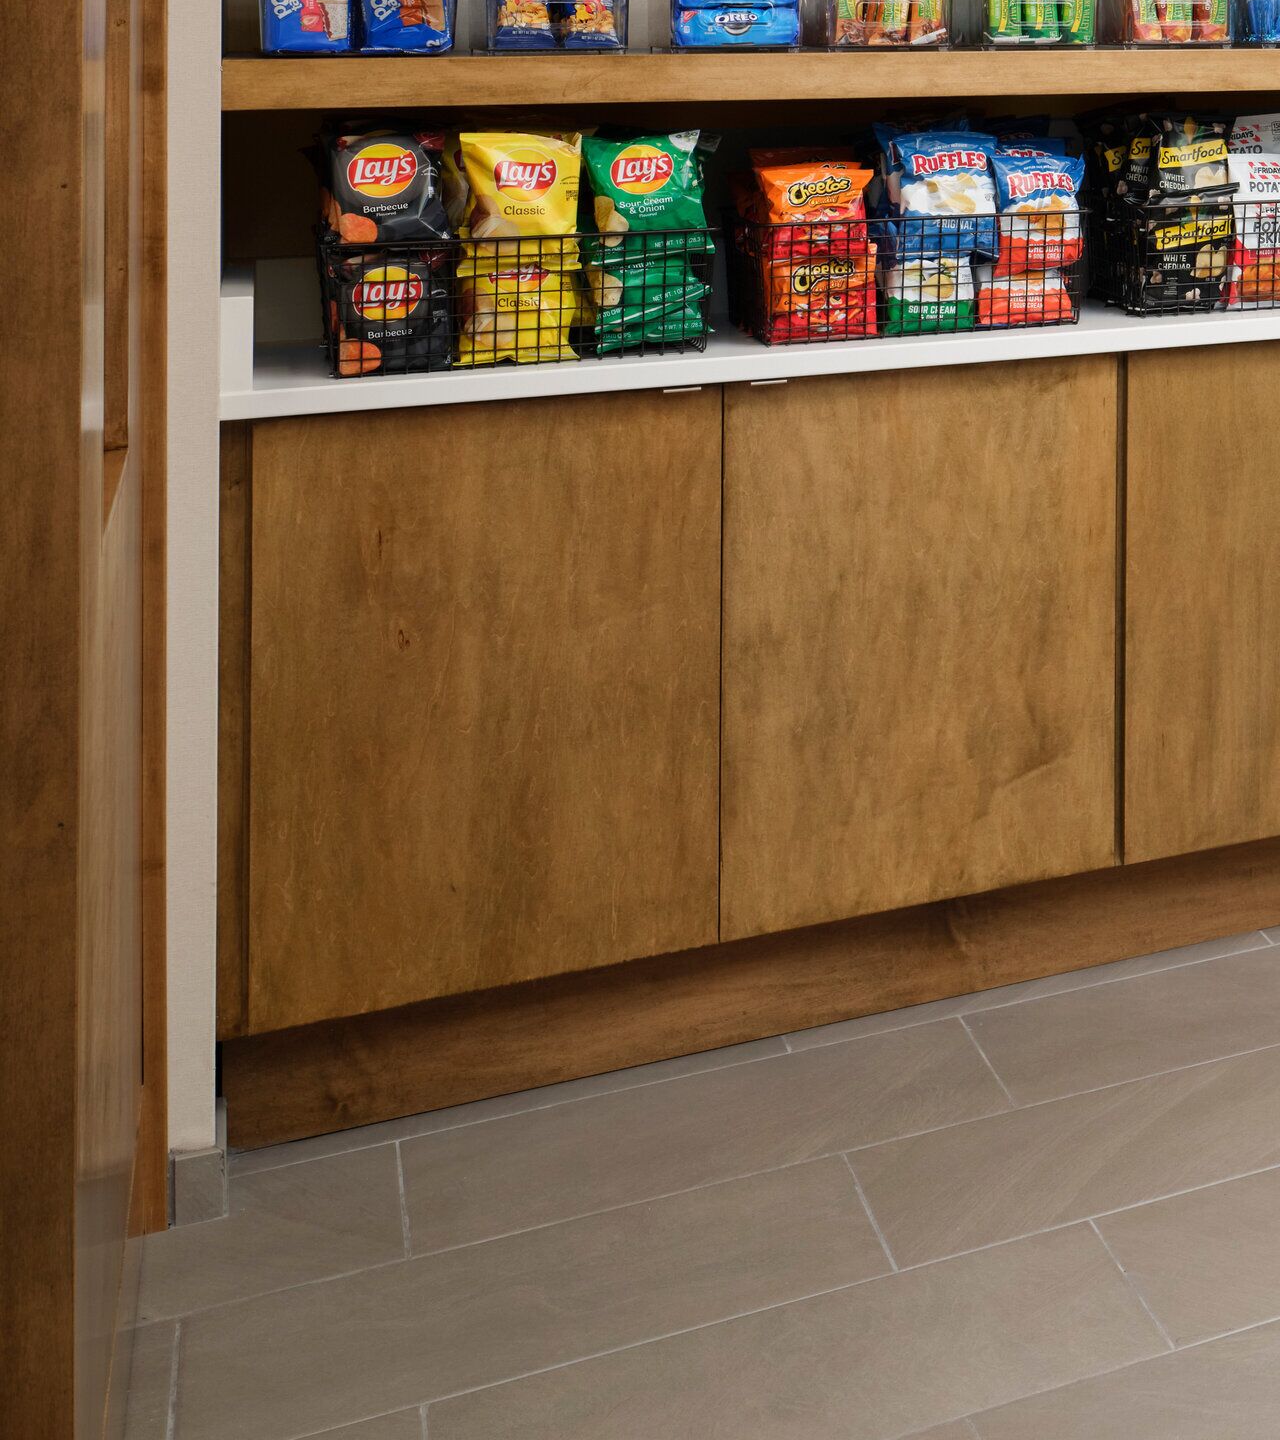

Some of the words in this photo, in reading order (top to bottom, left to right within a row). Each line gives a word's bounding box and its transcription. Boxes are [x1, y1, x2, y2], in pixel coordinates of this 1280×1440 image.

[913, 151, 988, 174] RUFFLES
[1161, 144, 1224, 165] Smartfood
[354, 154, 413, 186] Lay's
[500, 161, 554, 191] Lay's
[617, 154, 670, 184] Lay's
[1164, 172, 1185, 183] WHITE
[788, 177, 851, 206] Cheetos
[363, 201, 409, 214] Barbecue
[504, 205, 546, 216] Classic
[619, 199, 642, 210] Sour
[638, 203, 665, 214] Onion
[1161, 220, 1226, 245] Smartfood
